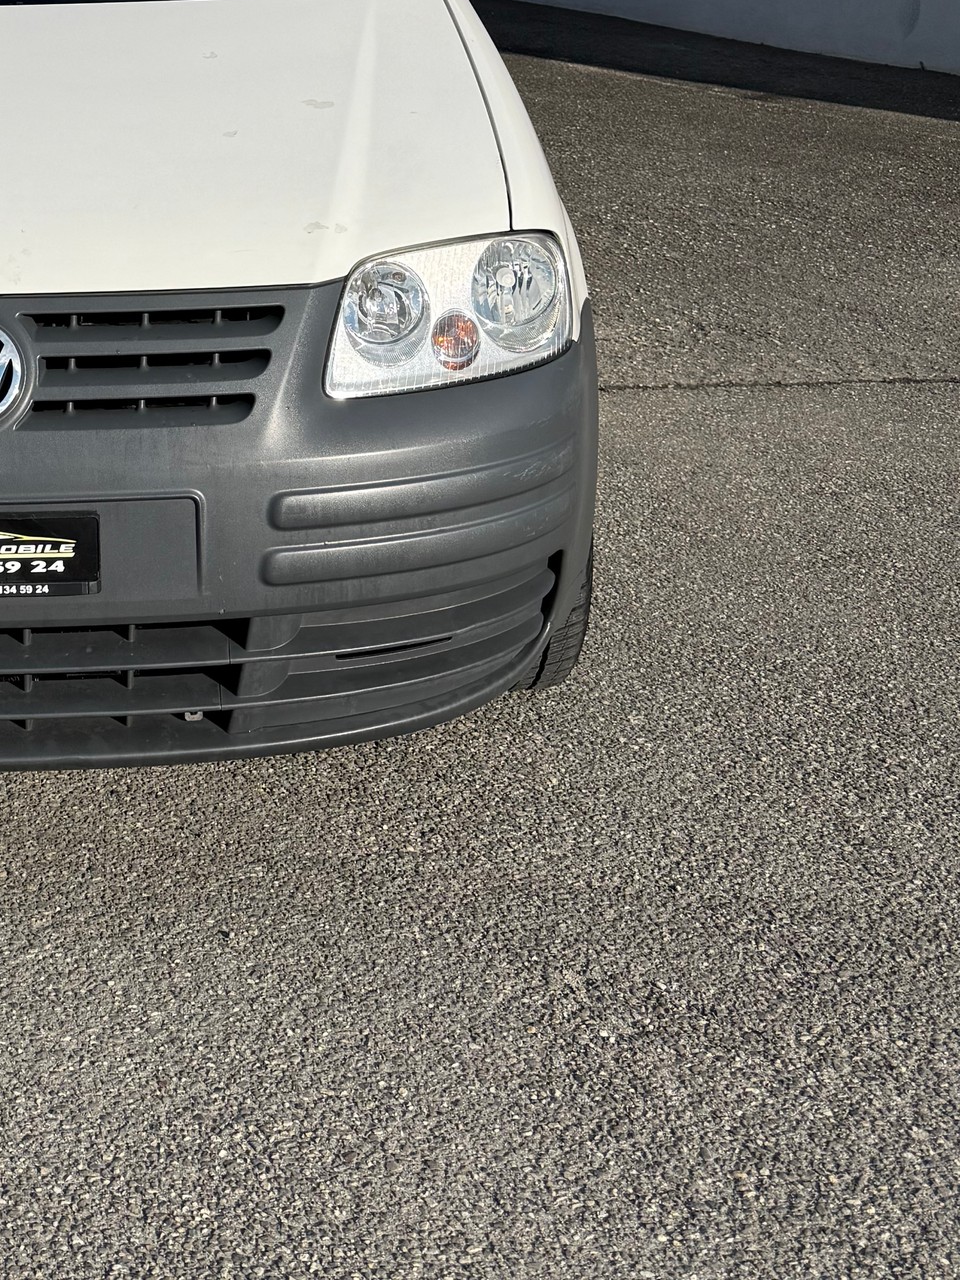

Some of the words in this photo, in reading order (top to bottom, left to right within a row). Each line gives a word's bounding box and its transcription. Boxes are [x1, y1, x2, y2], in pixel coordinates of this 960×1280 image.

[30, 560, 65, 573] 24
[19, 585, 33, 594] 59
[35, 585, 49, 593] 24
